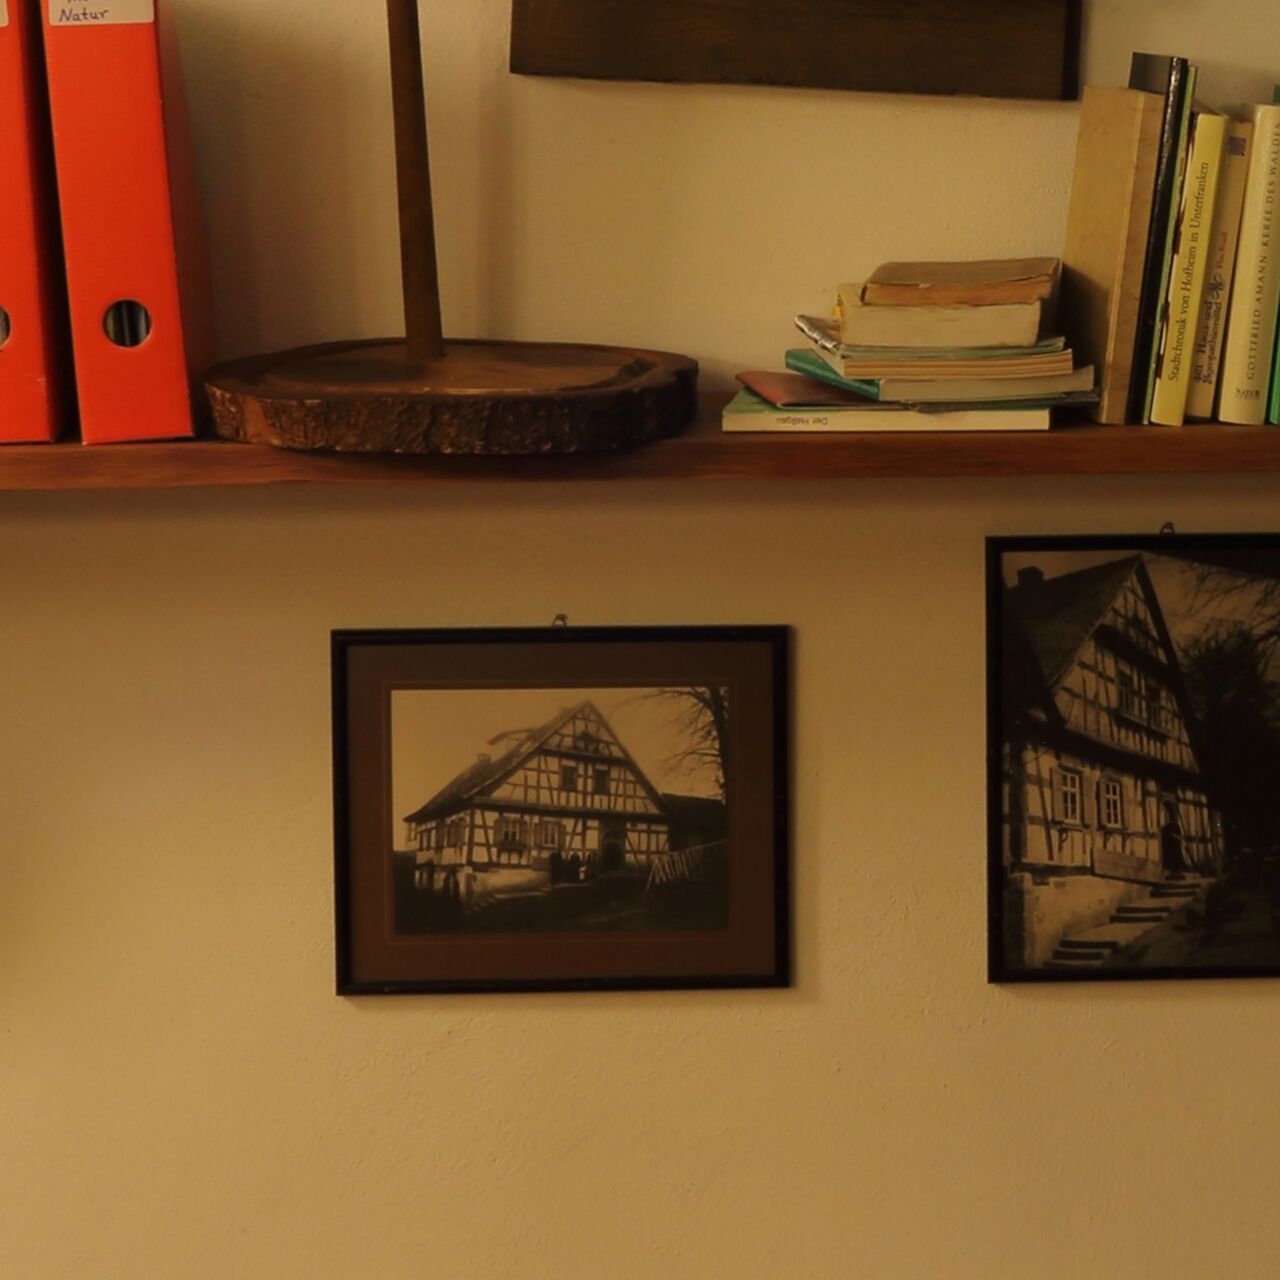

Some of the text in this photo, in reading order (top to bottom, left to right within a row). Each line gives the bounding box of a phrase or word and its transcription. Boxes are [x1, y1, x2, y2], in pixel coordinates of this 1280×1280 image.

[59, 8, 108, 22] Natur
[1189, 161, 1209, 229] Unterfranken
[1180, 245, 1196, 291] Hofheim
[1247, 309, 1261, 380] GOTTFRIED
[1256, 255, 1268, 304] AMANN
[1266, 181, 1275, 204] DES
[1181, 295, 1190, 315] von
[1168, 319, 1186, 381] Stadtchronik
